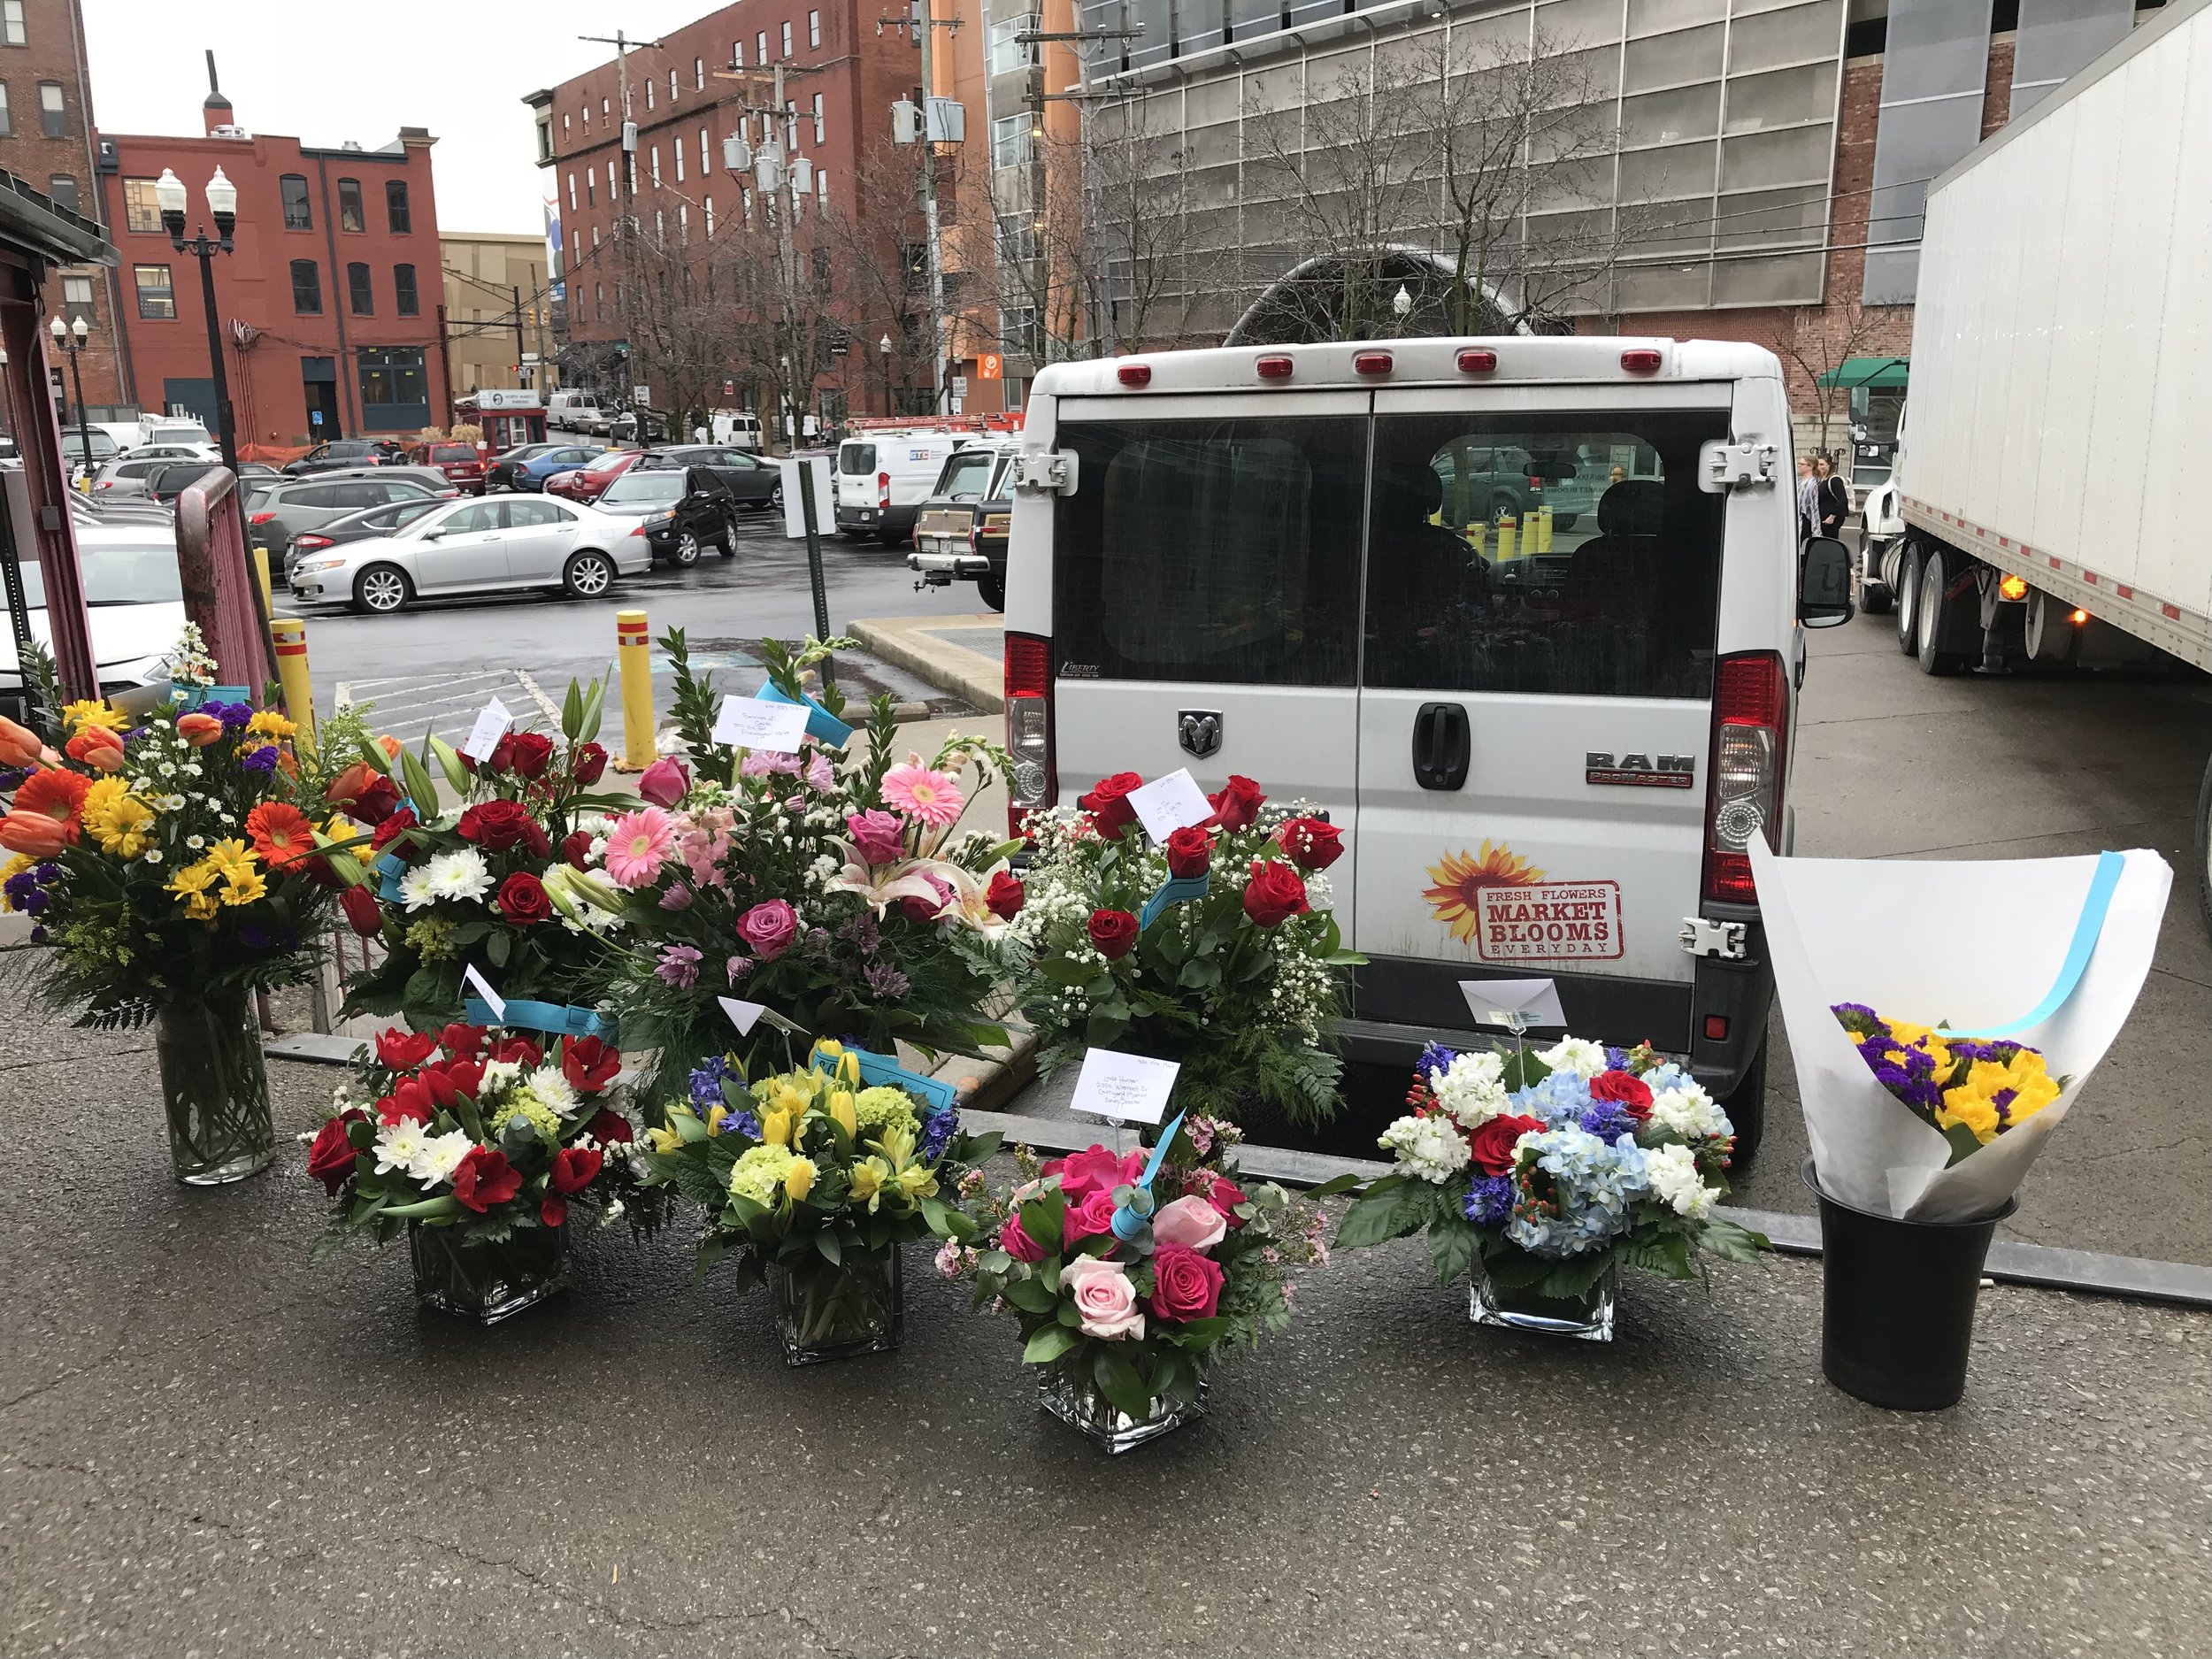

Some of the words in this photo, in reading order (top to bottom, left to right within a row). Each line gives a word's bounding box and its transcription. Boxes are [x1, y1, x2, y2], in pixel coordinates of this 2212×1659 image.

[910, 450, 928, 460] GTC
[1586, 750, 1695, 772] RAM
[1486, 891, 1532, 902] FRESH
[1541, 888, 1606, 900] FLOWERS
[1486, 902, 1606, 923] MARKET
[1489, 922, 1609, 943] BLOOMS
[1491, 942, 1608, 954] EVERYDAY
